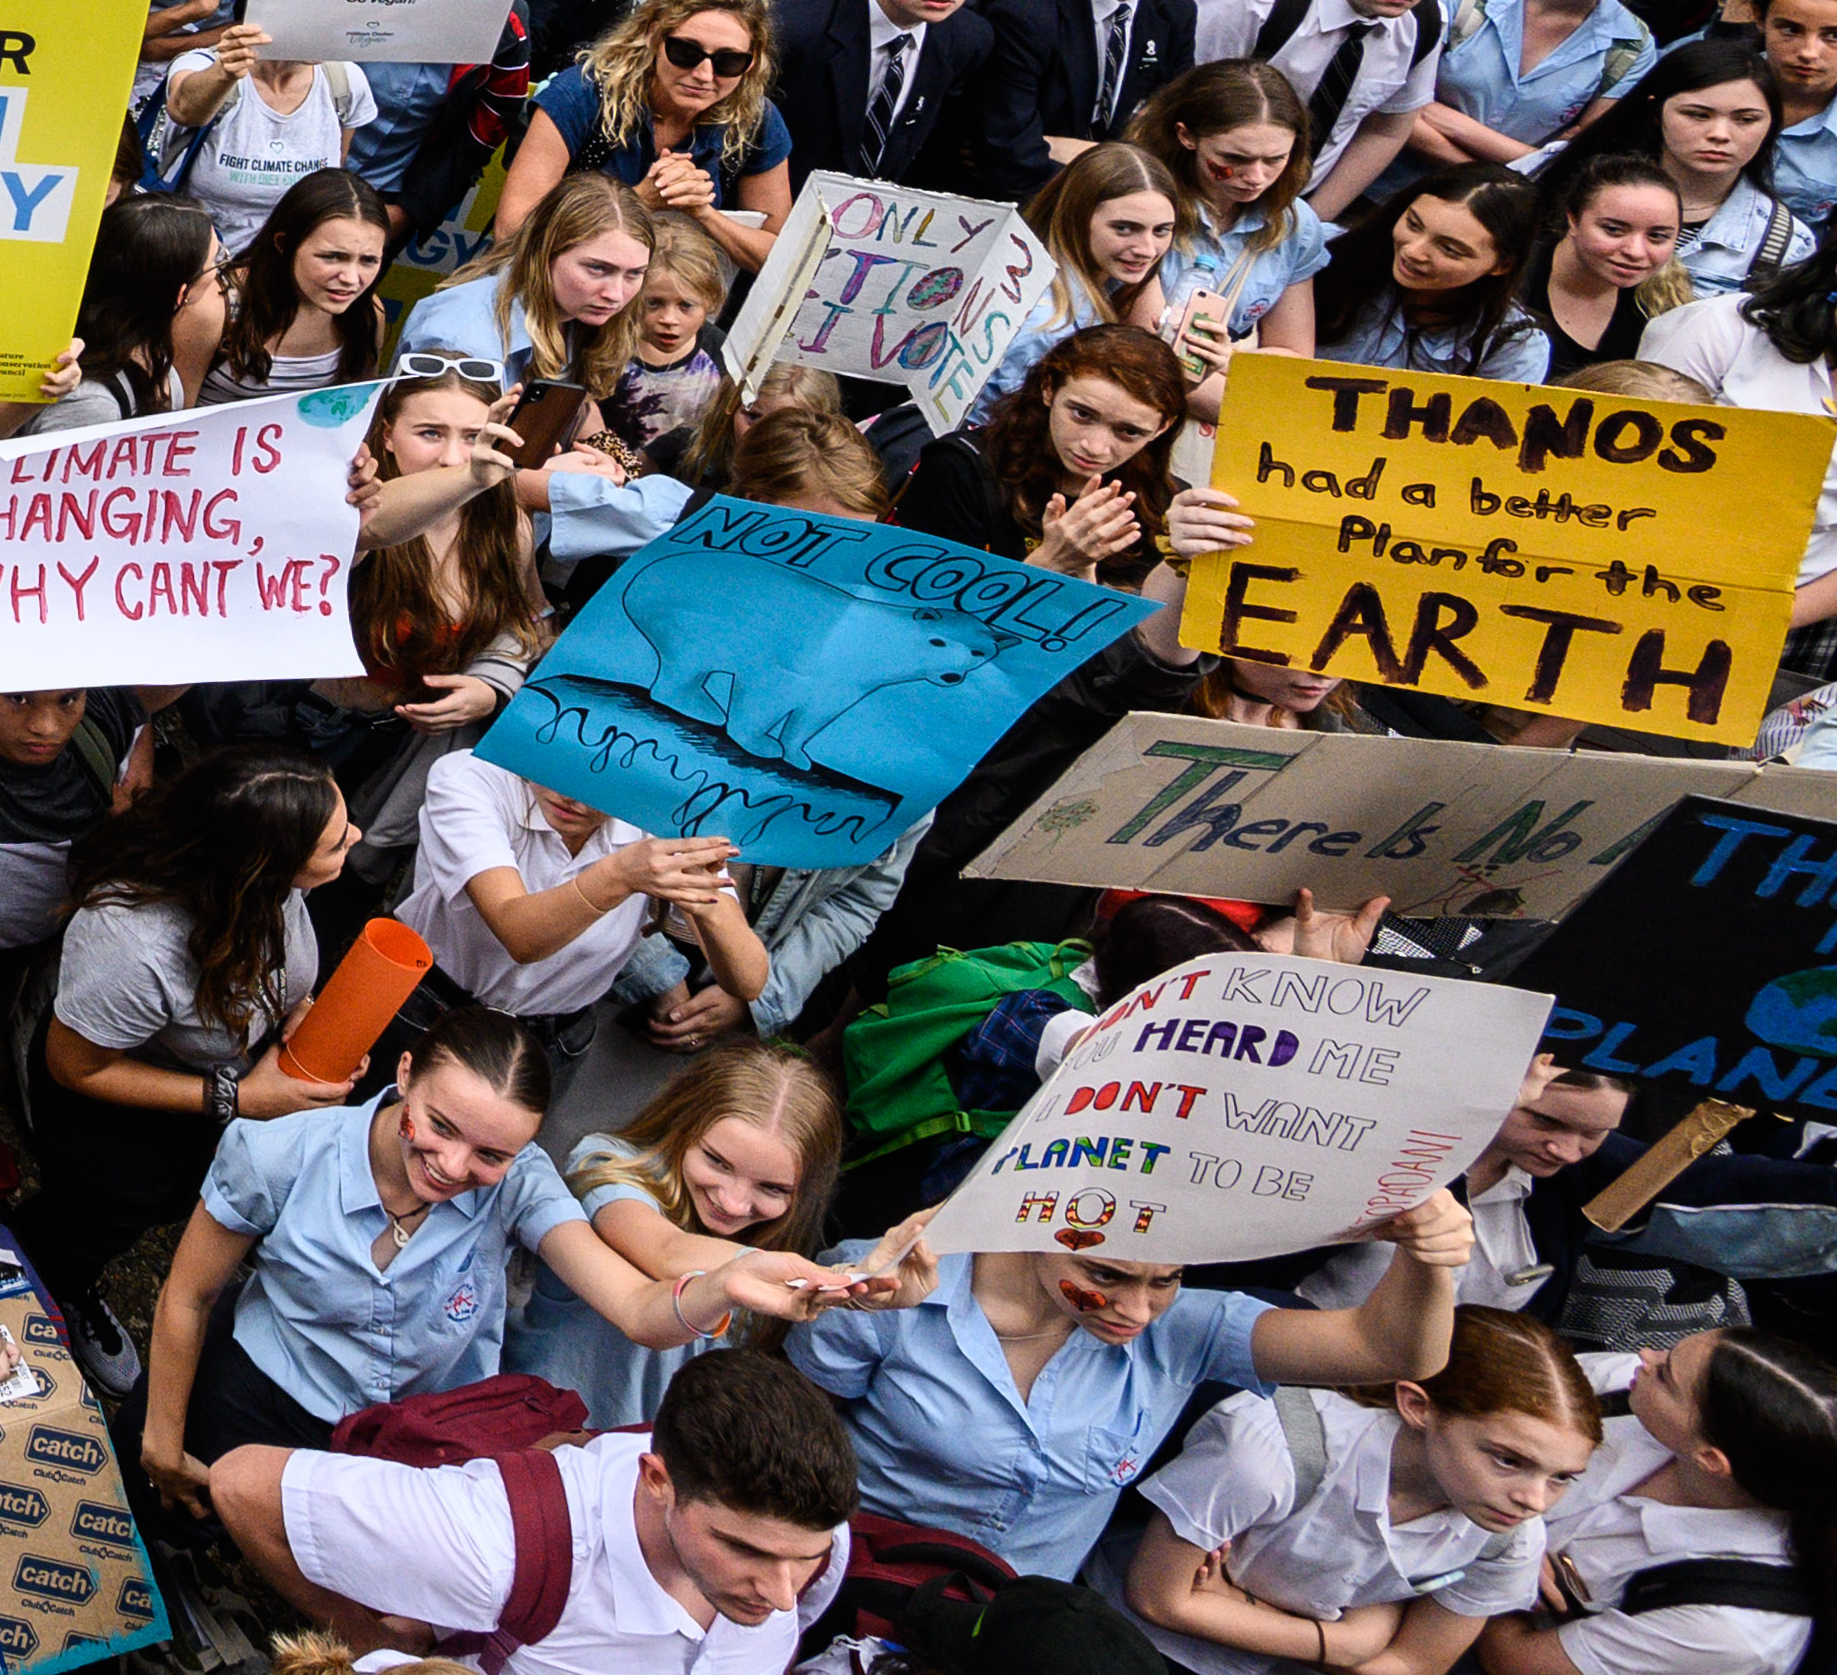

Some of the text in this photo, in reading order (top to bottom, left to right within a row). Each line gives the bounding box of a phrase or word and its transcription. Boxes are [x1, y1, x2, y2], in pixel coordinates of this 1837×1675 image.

[231, 422, 284, 476] IS
[1304, 375, 1727, 475] THANOS
[1256, 440, 1658, 532] had a better
[113, 556, 241, 622] CANT
[256, 551, 342, 618] WE?
[1336, 513, 1727, 614] Plan for the
[1218, 559, 1735, 726] EARTH
